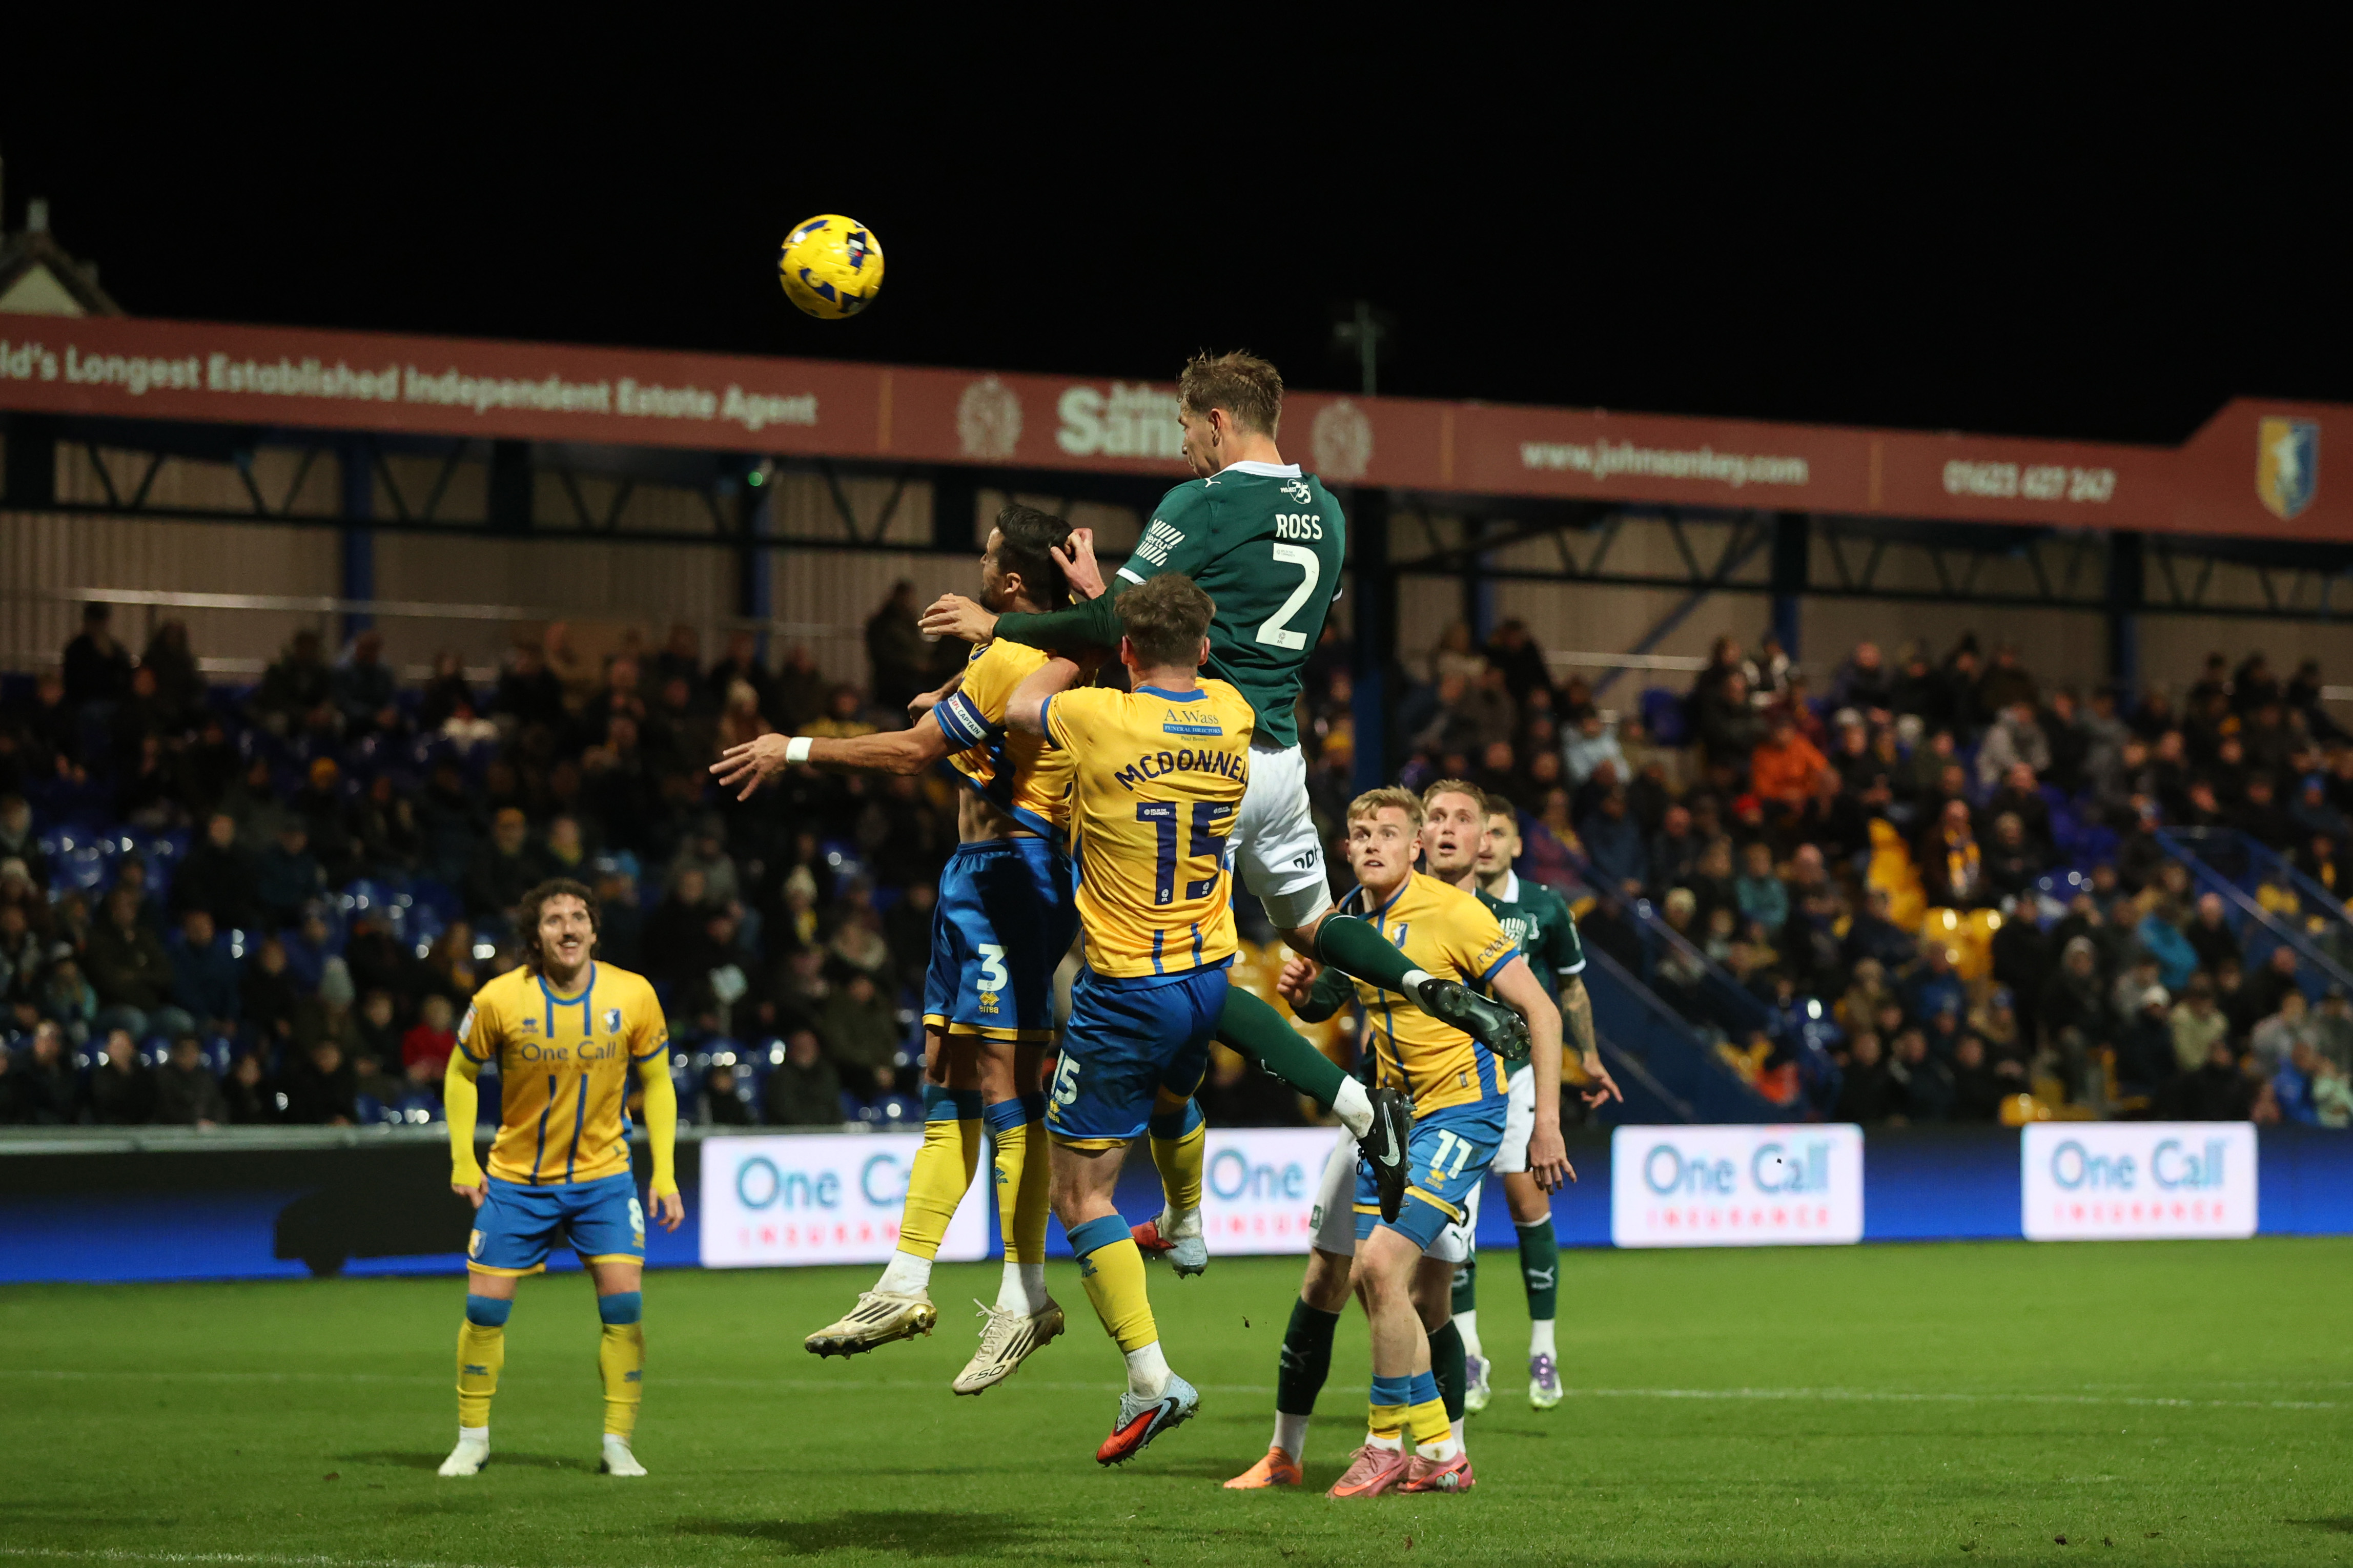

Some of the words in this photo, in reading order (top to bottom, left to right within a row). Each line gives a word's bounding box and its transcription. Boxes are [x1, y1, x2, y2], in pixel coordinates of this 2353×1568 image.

[66, 346, 200, 396] Longest
[209, 354, 400, 403] Established
[404, 365, 611, 414] Independent
[617, 378, 717, 420] Estate
[721, 383, 817, 431] Agent
[1057, 387, 1185, 458] San
[1145, 533, 1168, 550] vertu
[1275, 514, 1322, 540] ROSS
[1255, 543, 1320, 650] 2
[952, 700, 960, 710] EFL
[958, 710, 980, 735] CAPTAIN
[1114, 749, 1249, 792] MCDONNEL
[1136, 801, 1234, 905] 15
[977, 943, 1008, 991] 3
[522, 1043, 568, 1061] One
[578, 1041, 616, 1059] Call
[1051, 1048, 1080, 1104] 15
[1209, 1149, 1304, 1201] One
[1429, 1129, 1473, 1179] 11
[1645, 1144, 1736, 1195] One
[2051, 1140, 2136, 1191] One
[736, 1156, 840, 1211] One
[628, 1197, 645, 1234] 8
[740, 1221, 901, 1247] INSURAN
